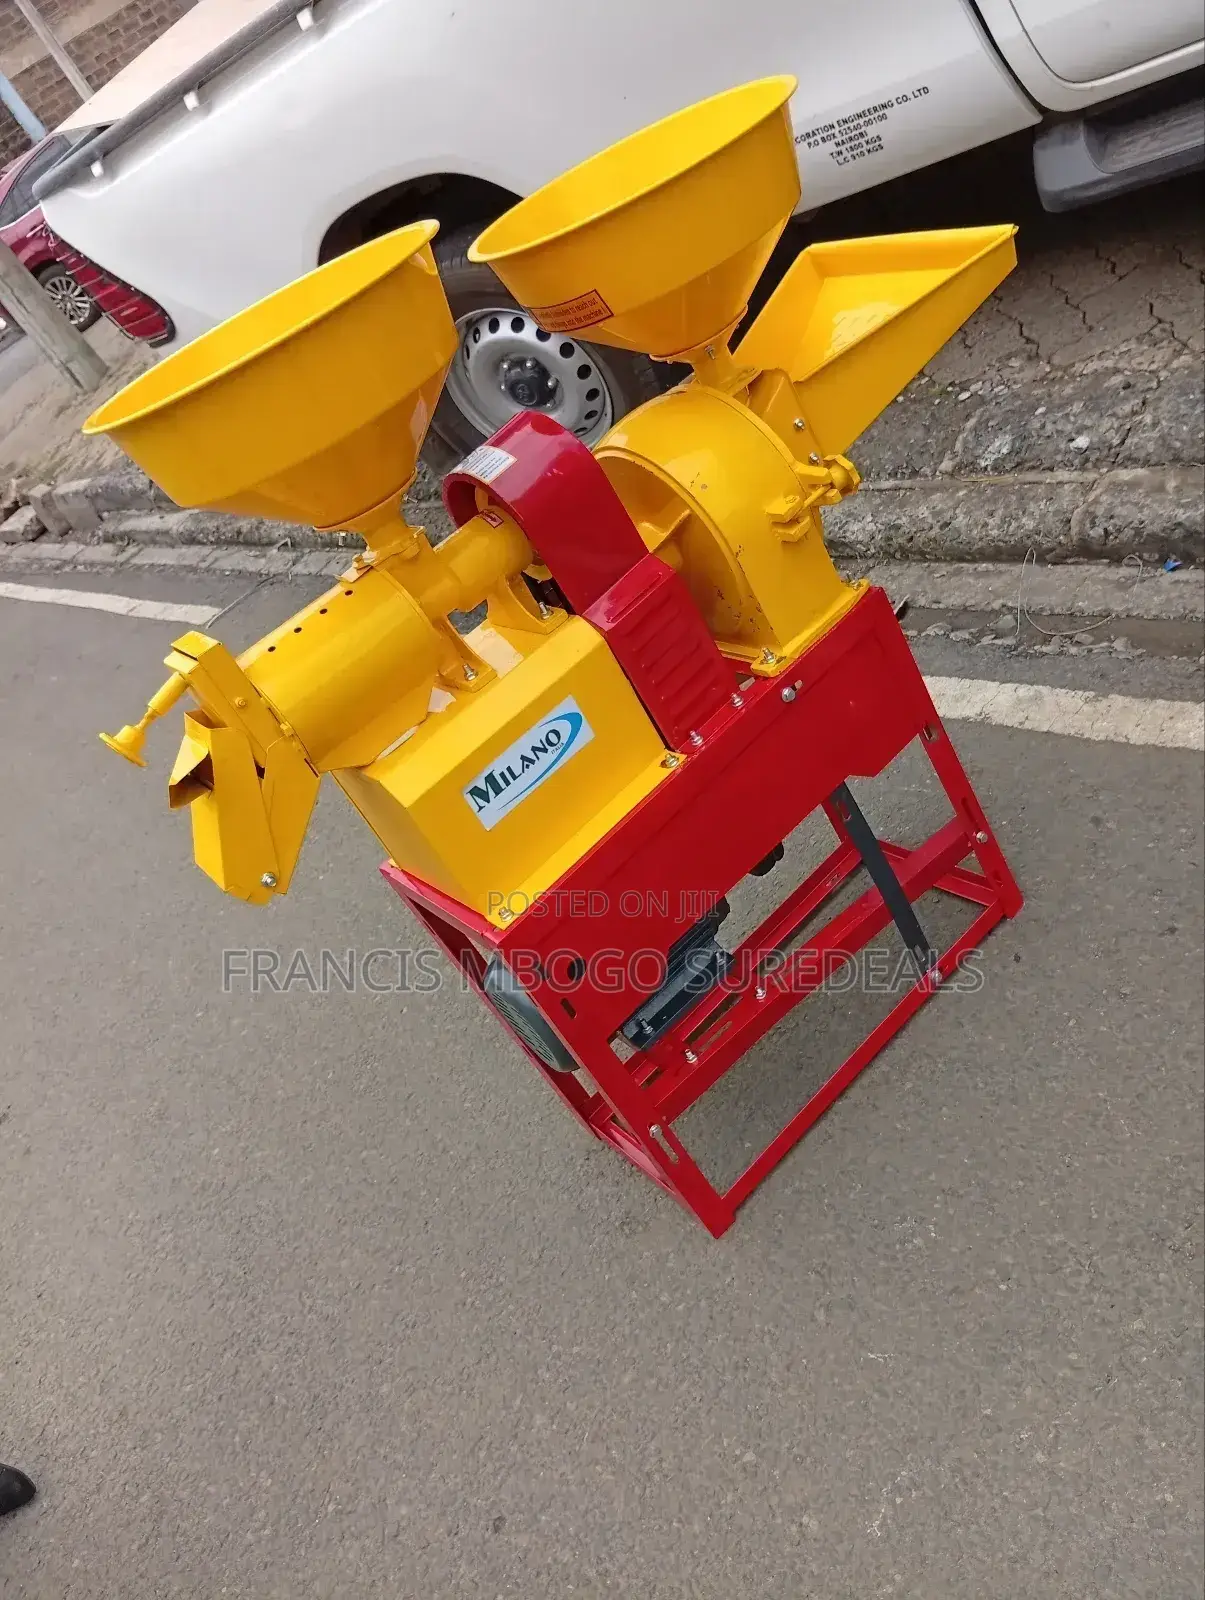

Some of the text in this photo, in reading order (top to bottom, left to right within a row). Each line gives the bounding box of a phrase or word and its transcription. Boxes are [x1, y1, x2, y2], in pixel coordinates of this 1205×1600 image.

[836, 100, 894, 128] ENGINEERING
[912, 86, 930, 99] LTD
[820, 133, 837, 144] BOX
[834, 130, 868, 148] NAIROBI
[865, 134, 882, 145] KGS
[866, 143, 884, 155] KGS
[466, 729, 561, 813] MILANO
